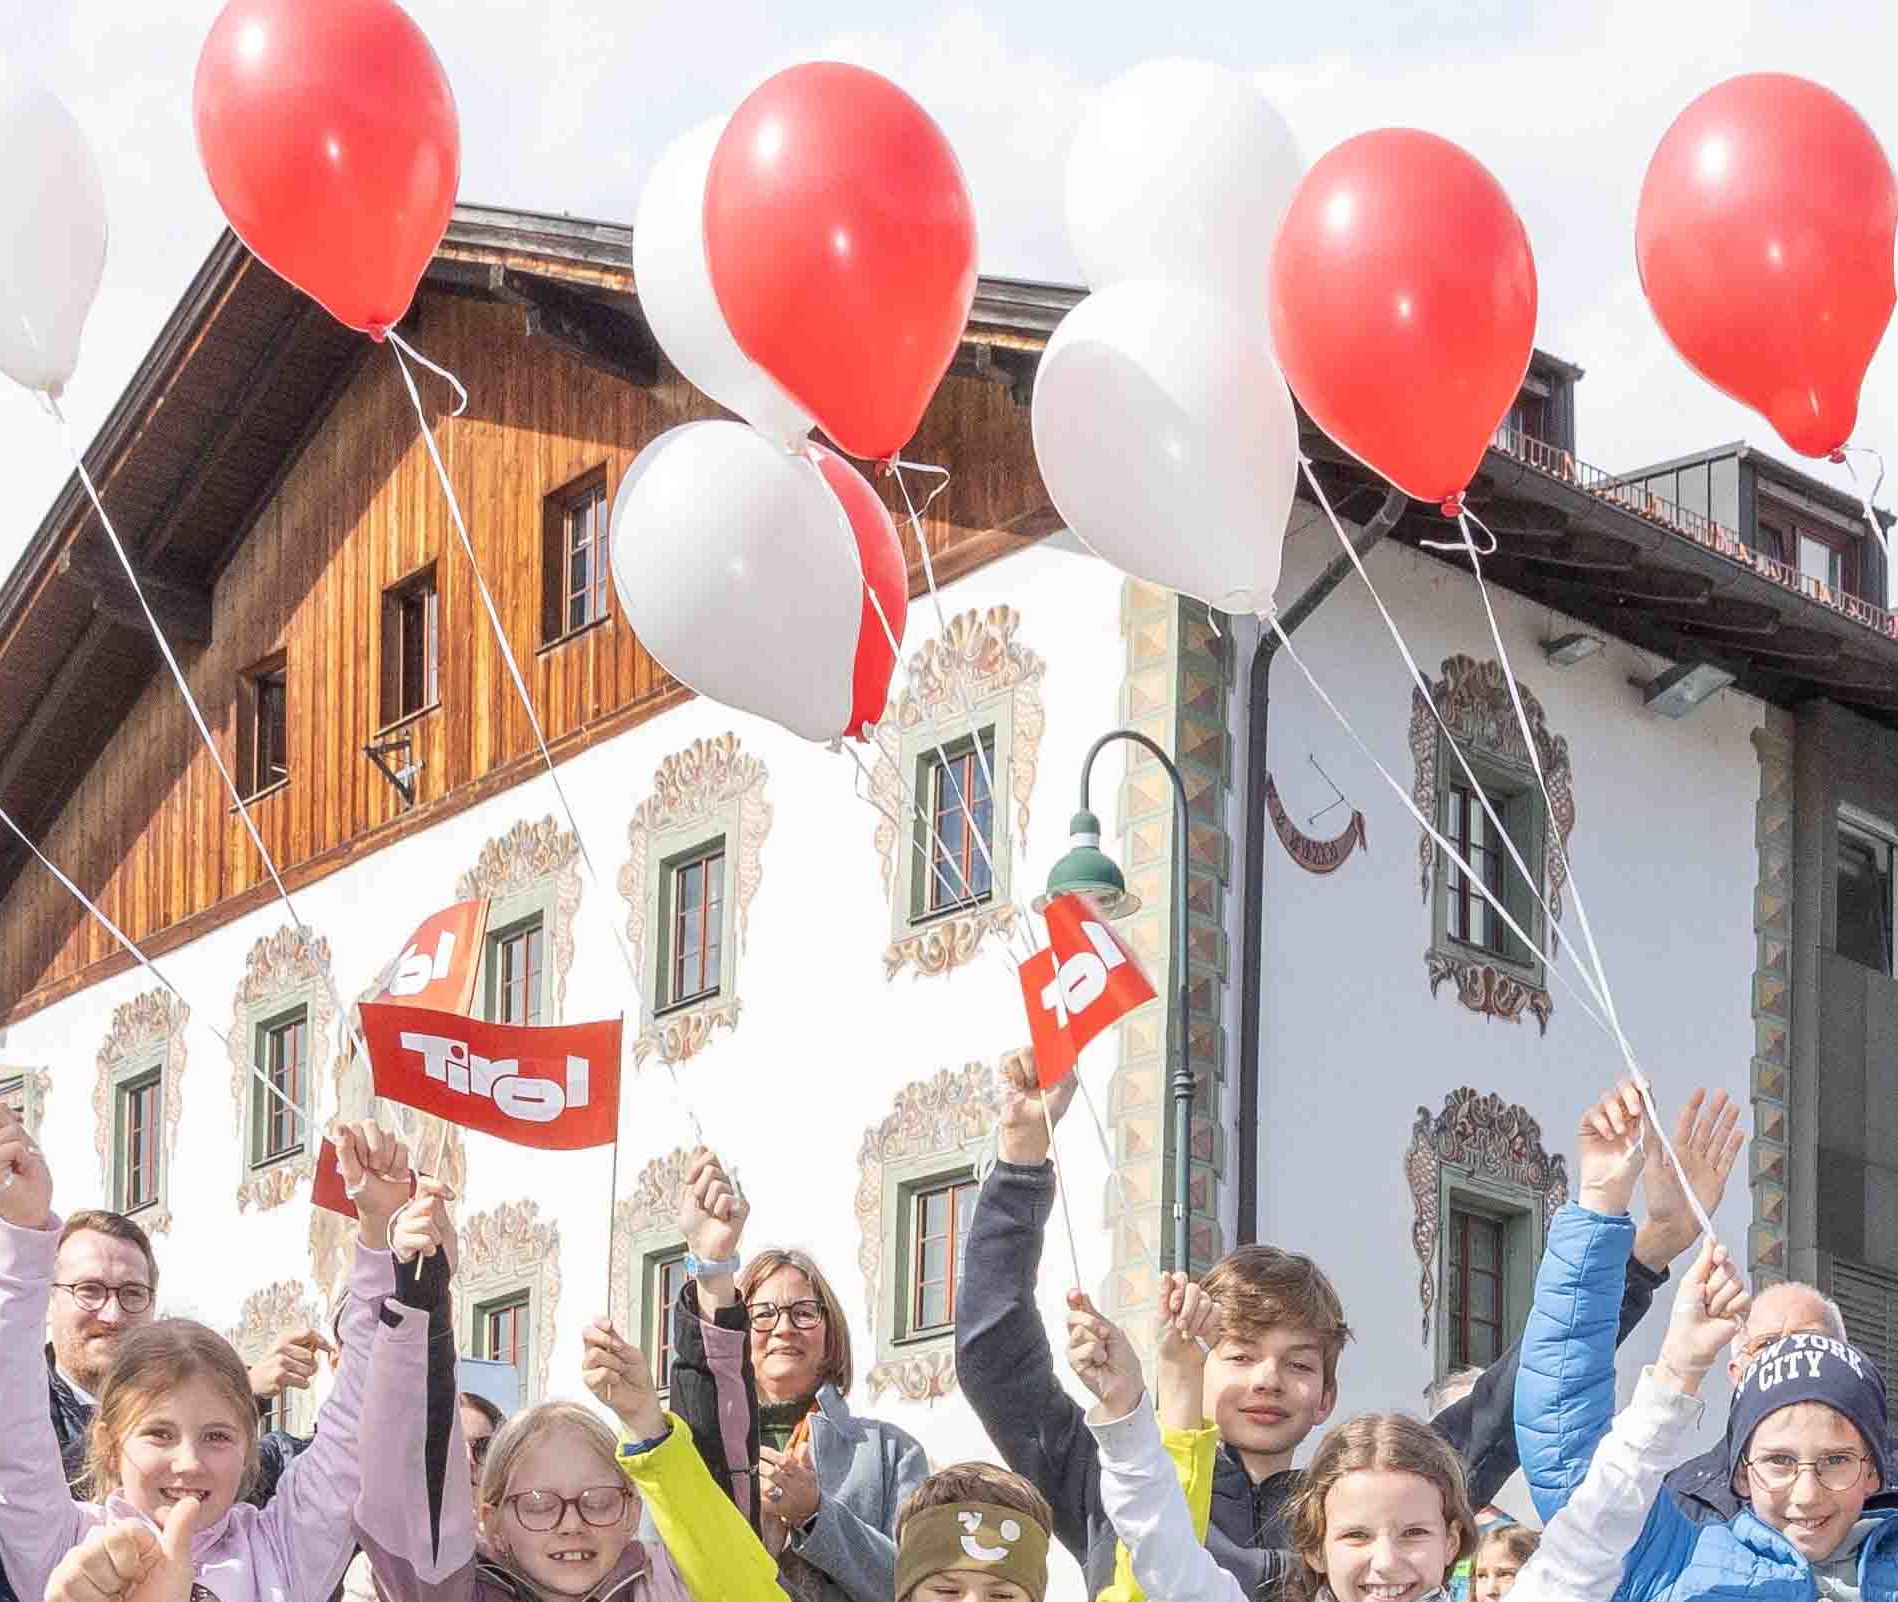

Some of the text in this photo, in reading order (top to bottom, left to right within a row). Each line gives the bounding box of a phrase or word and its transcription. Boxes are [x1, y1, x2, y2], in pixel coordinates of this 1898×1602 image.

[399, 1031, 590, 1123] Tirol
[1758, 1350, 1824, 1392] CITY
[1791, 1334, 1863, 1380] YORK
